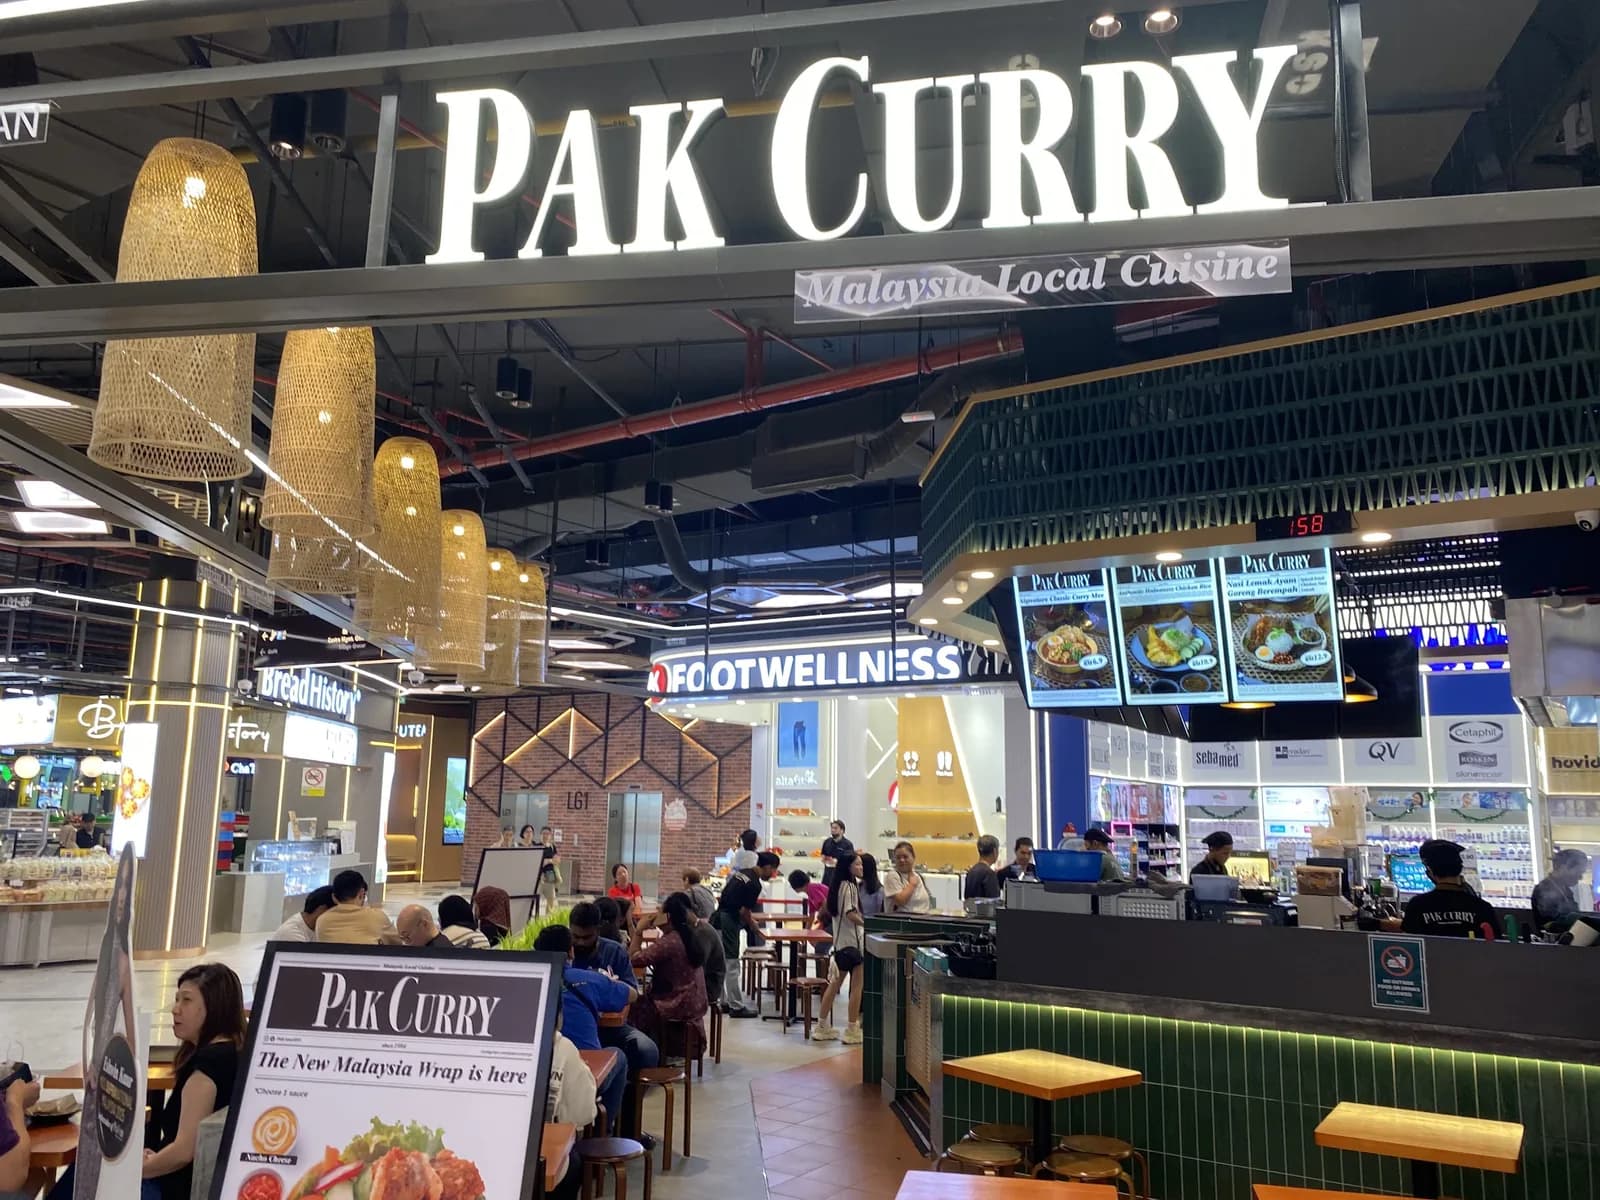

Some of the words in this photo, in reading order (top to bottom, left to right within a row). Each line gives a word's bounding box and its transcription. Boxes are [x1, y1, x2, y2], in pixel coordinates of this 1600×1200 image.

[425, 88, 726, 265] PAK
[771, 45, 1298, 242] CURRY
[802, 267, 984, 309] Malaysia
[996, 257, 1106, 296] Local
[1119, 250, 1278, 289] Cuisine
[1131, 564, 1156, 583] PAK
[1157, 562, 1197, 581] CURRY
[1242, 554, 1268, 573] PAK
[1268, 552, 1311, 572] CURRY
[1031, 573, 1053, 591] PAK
[1054, 570, 1091, 590] CURRY
[671, 645, 961, 693] FOOTWELLNESS
[1454, 726, 1497, 739] Cetaphil
[1196, 750, 1239, 768] sebamed
[1368, 741, 1400, 762] QV
[567, 791, 589, 810] LG1
[311, 972, 385, 1032] PAK
[388, 975, 501, 1038] CURRY
[257, 1051, 288, 1069] The
[292, 1053, 330, 1071] New
[333, 1054, 412, 1079] Malaysia
[418, 1061, 463, 1084] Wrap
[468, 1063, 482, 1082] is
[488, 1064, 528, 1085] here
